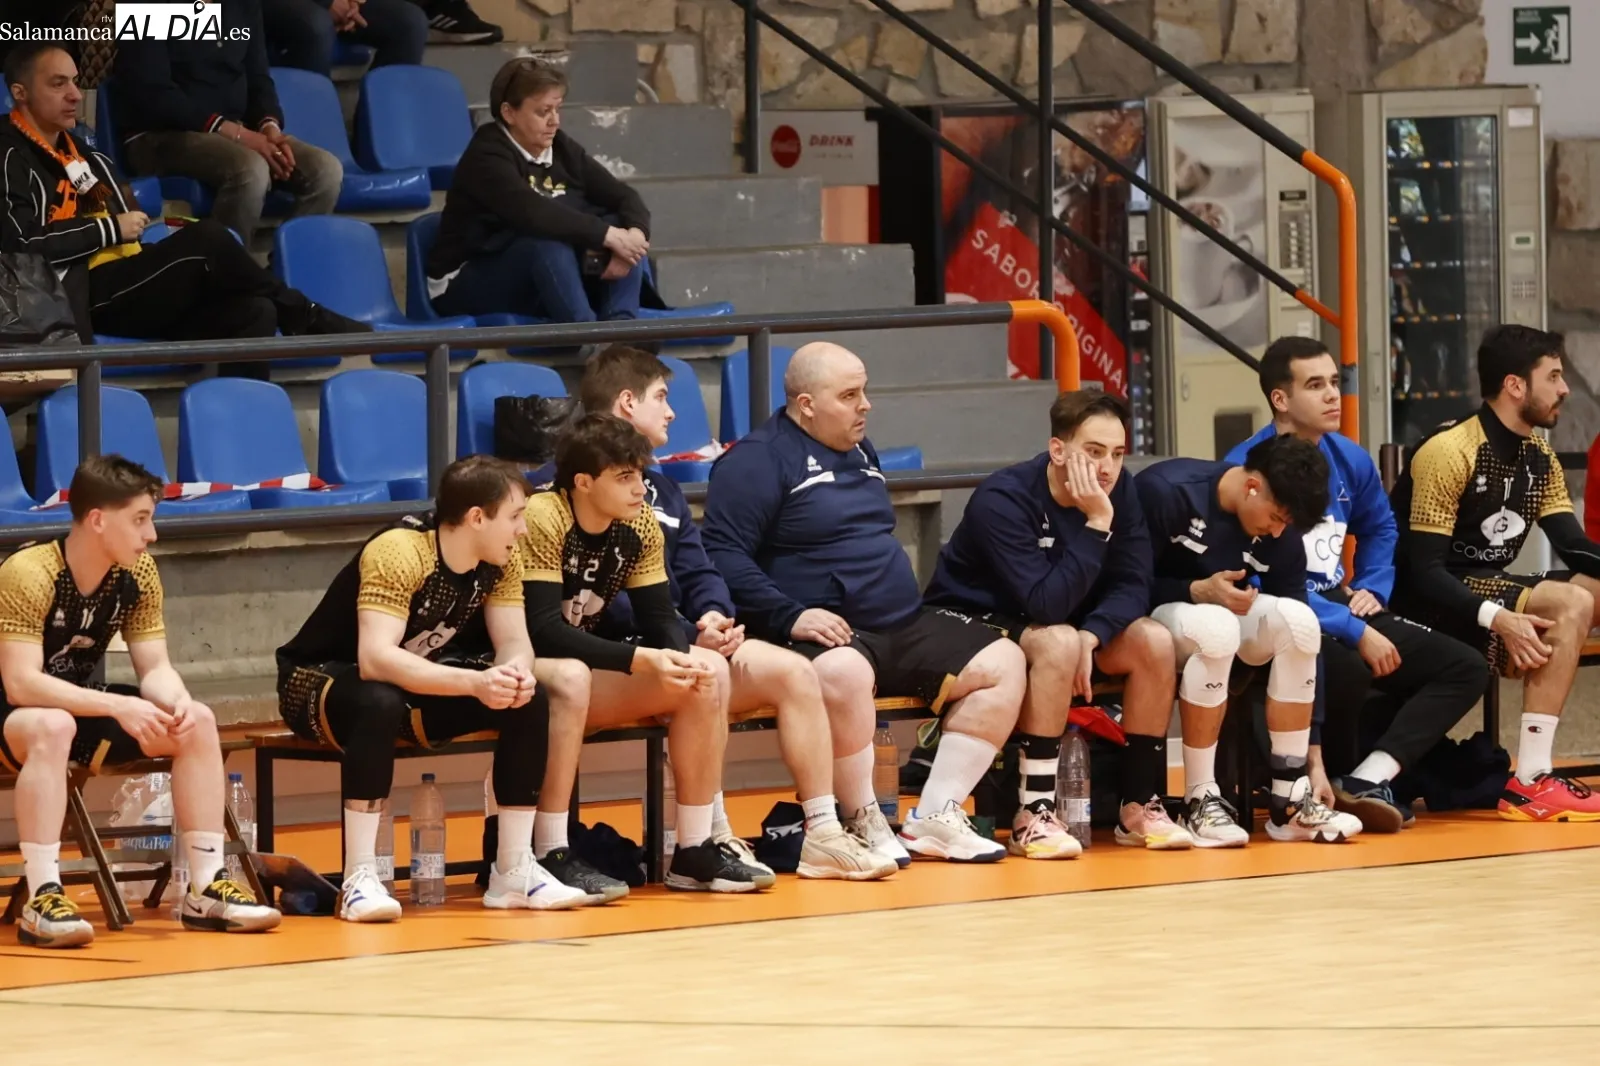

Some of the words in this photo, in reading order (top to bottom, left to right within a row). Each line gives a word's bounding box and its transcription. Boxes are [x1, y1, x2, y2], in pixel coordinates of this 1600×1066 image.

[809, 134, 855, 147] DRINK
[1453, 541, 1514, 561] CONGESA
[584, 559, 599, 582] 2
